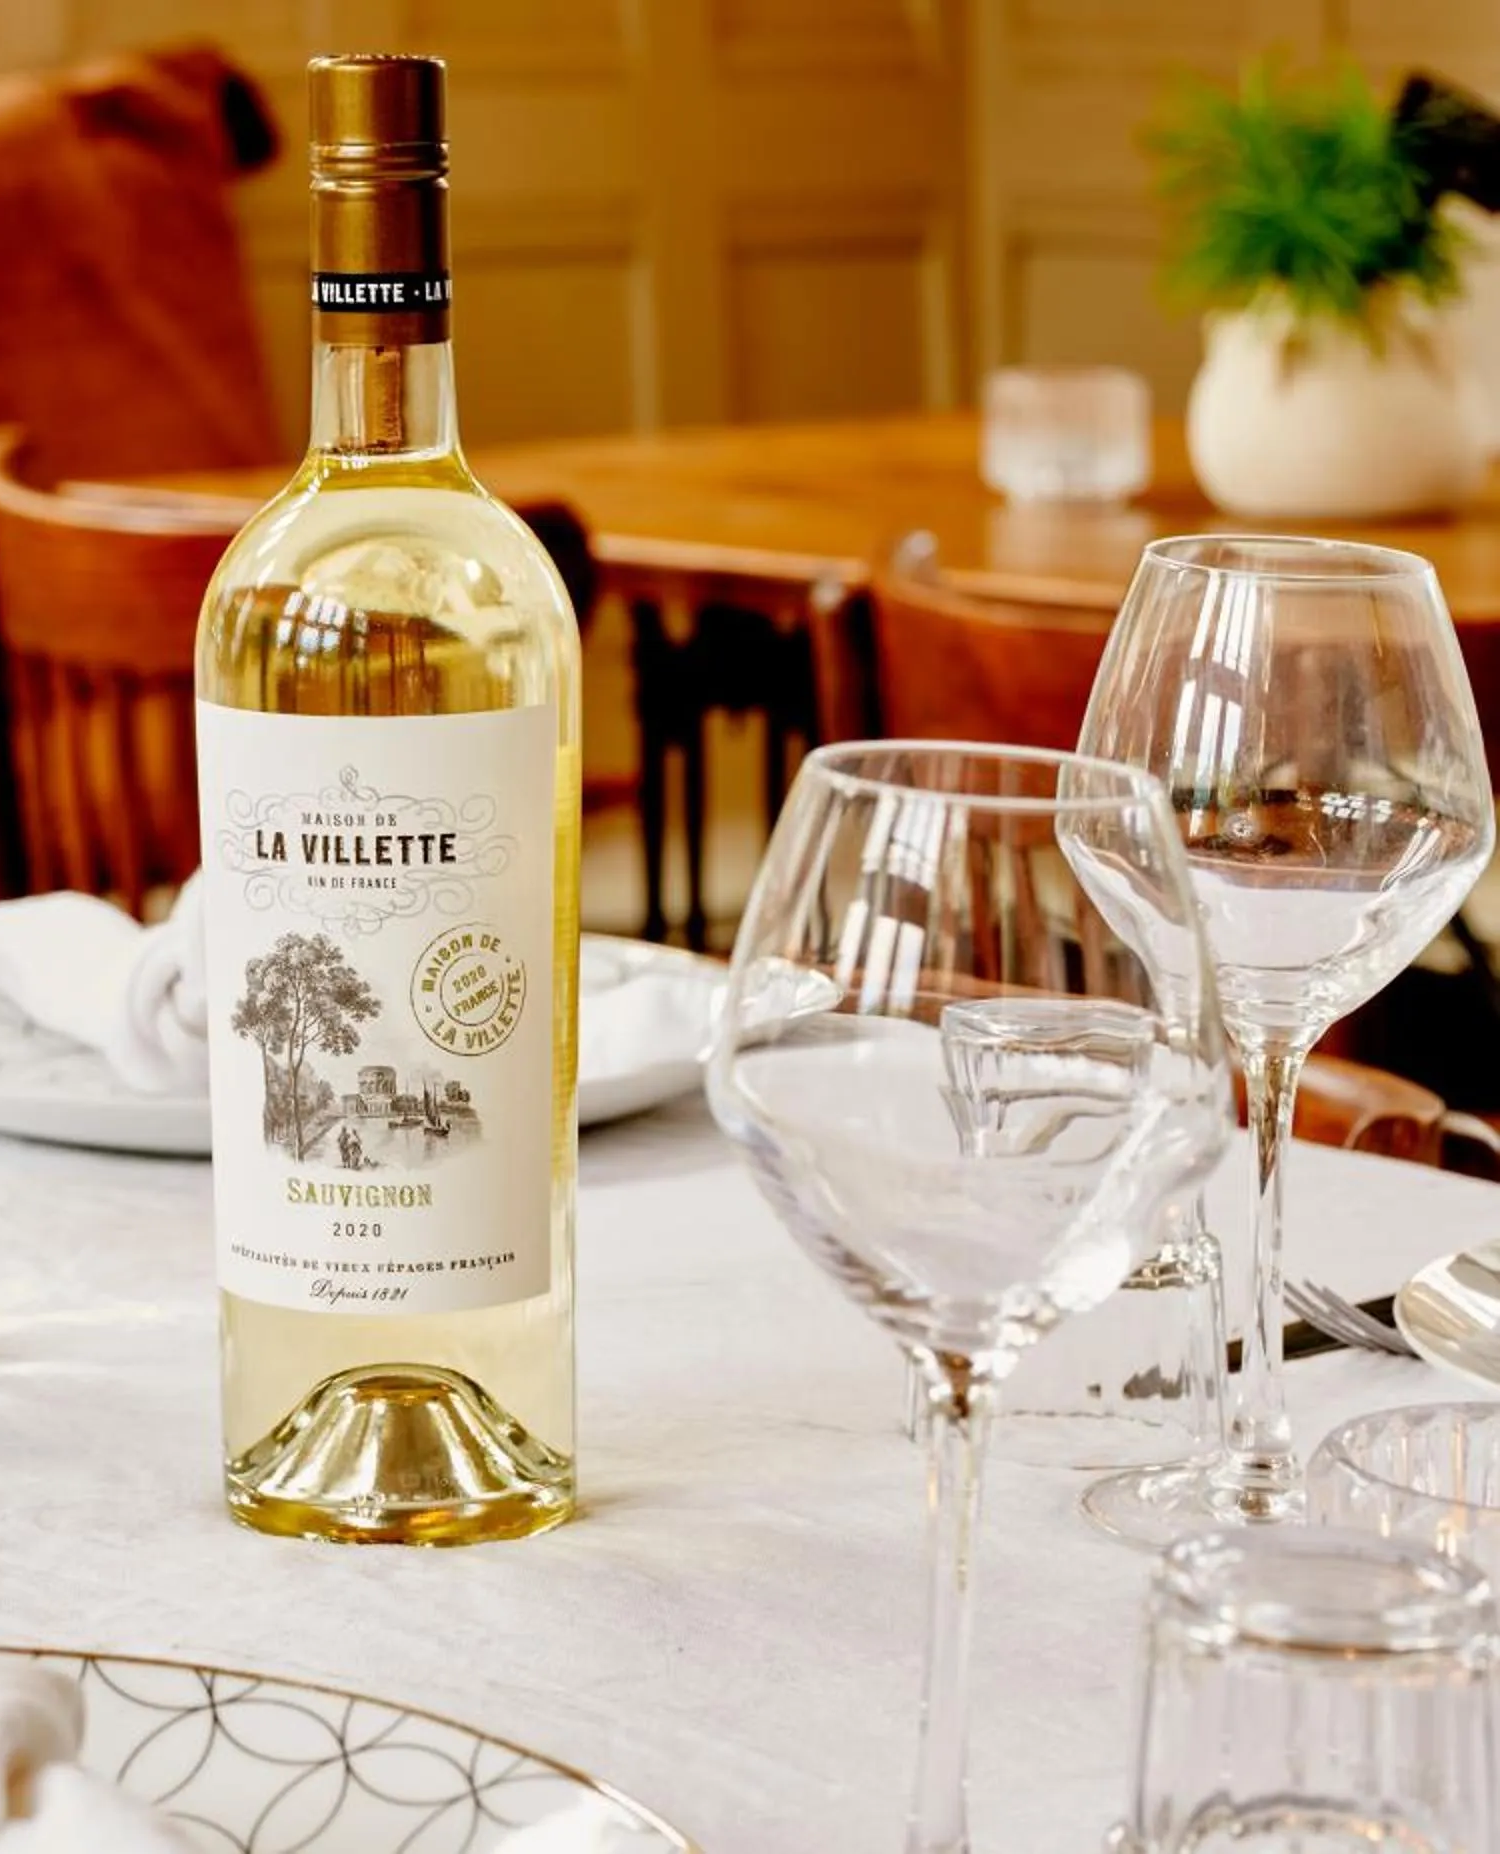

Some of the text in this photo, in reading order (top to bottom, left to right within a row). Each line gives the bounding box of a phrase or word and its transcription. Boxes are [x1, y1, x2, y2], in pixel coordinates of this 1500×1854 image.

[321, 282, 405, 303] VILLETTE
[424, 281, 442, 301] LA
[301, 812, 398, 828] MAISON DE
[256, 829, 457, 866] LA VILLETTE
[307, 875, 397, 890] VIN DE FRANCE
[421, 933, 501, 993] MAISON DE
[431, 967, 522, 1049] LA VILLETTE
[452, 979, 500, 1017] FRANCE
[286, 1176, 434, 1209] SAUVIGNON
[332, 1221, 383, 1238] 2020
[302, 1258, 319, 1271] DE
[325, 1261, 371, 1274] VIEUX
[309, 1278, 410, 1305] Depuis 1821
